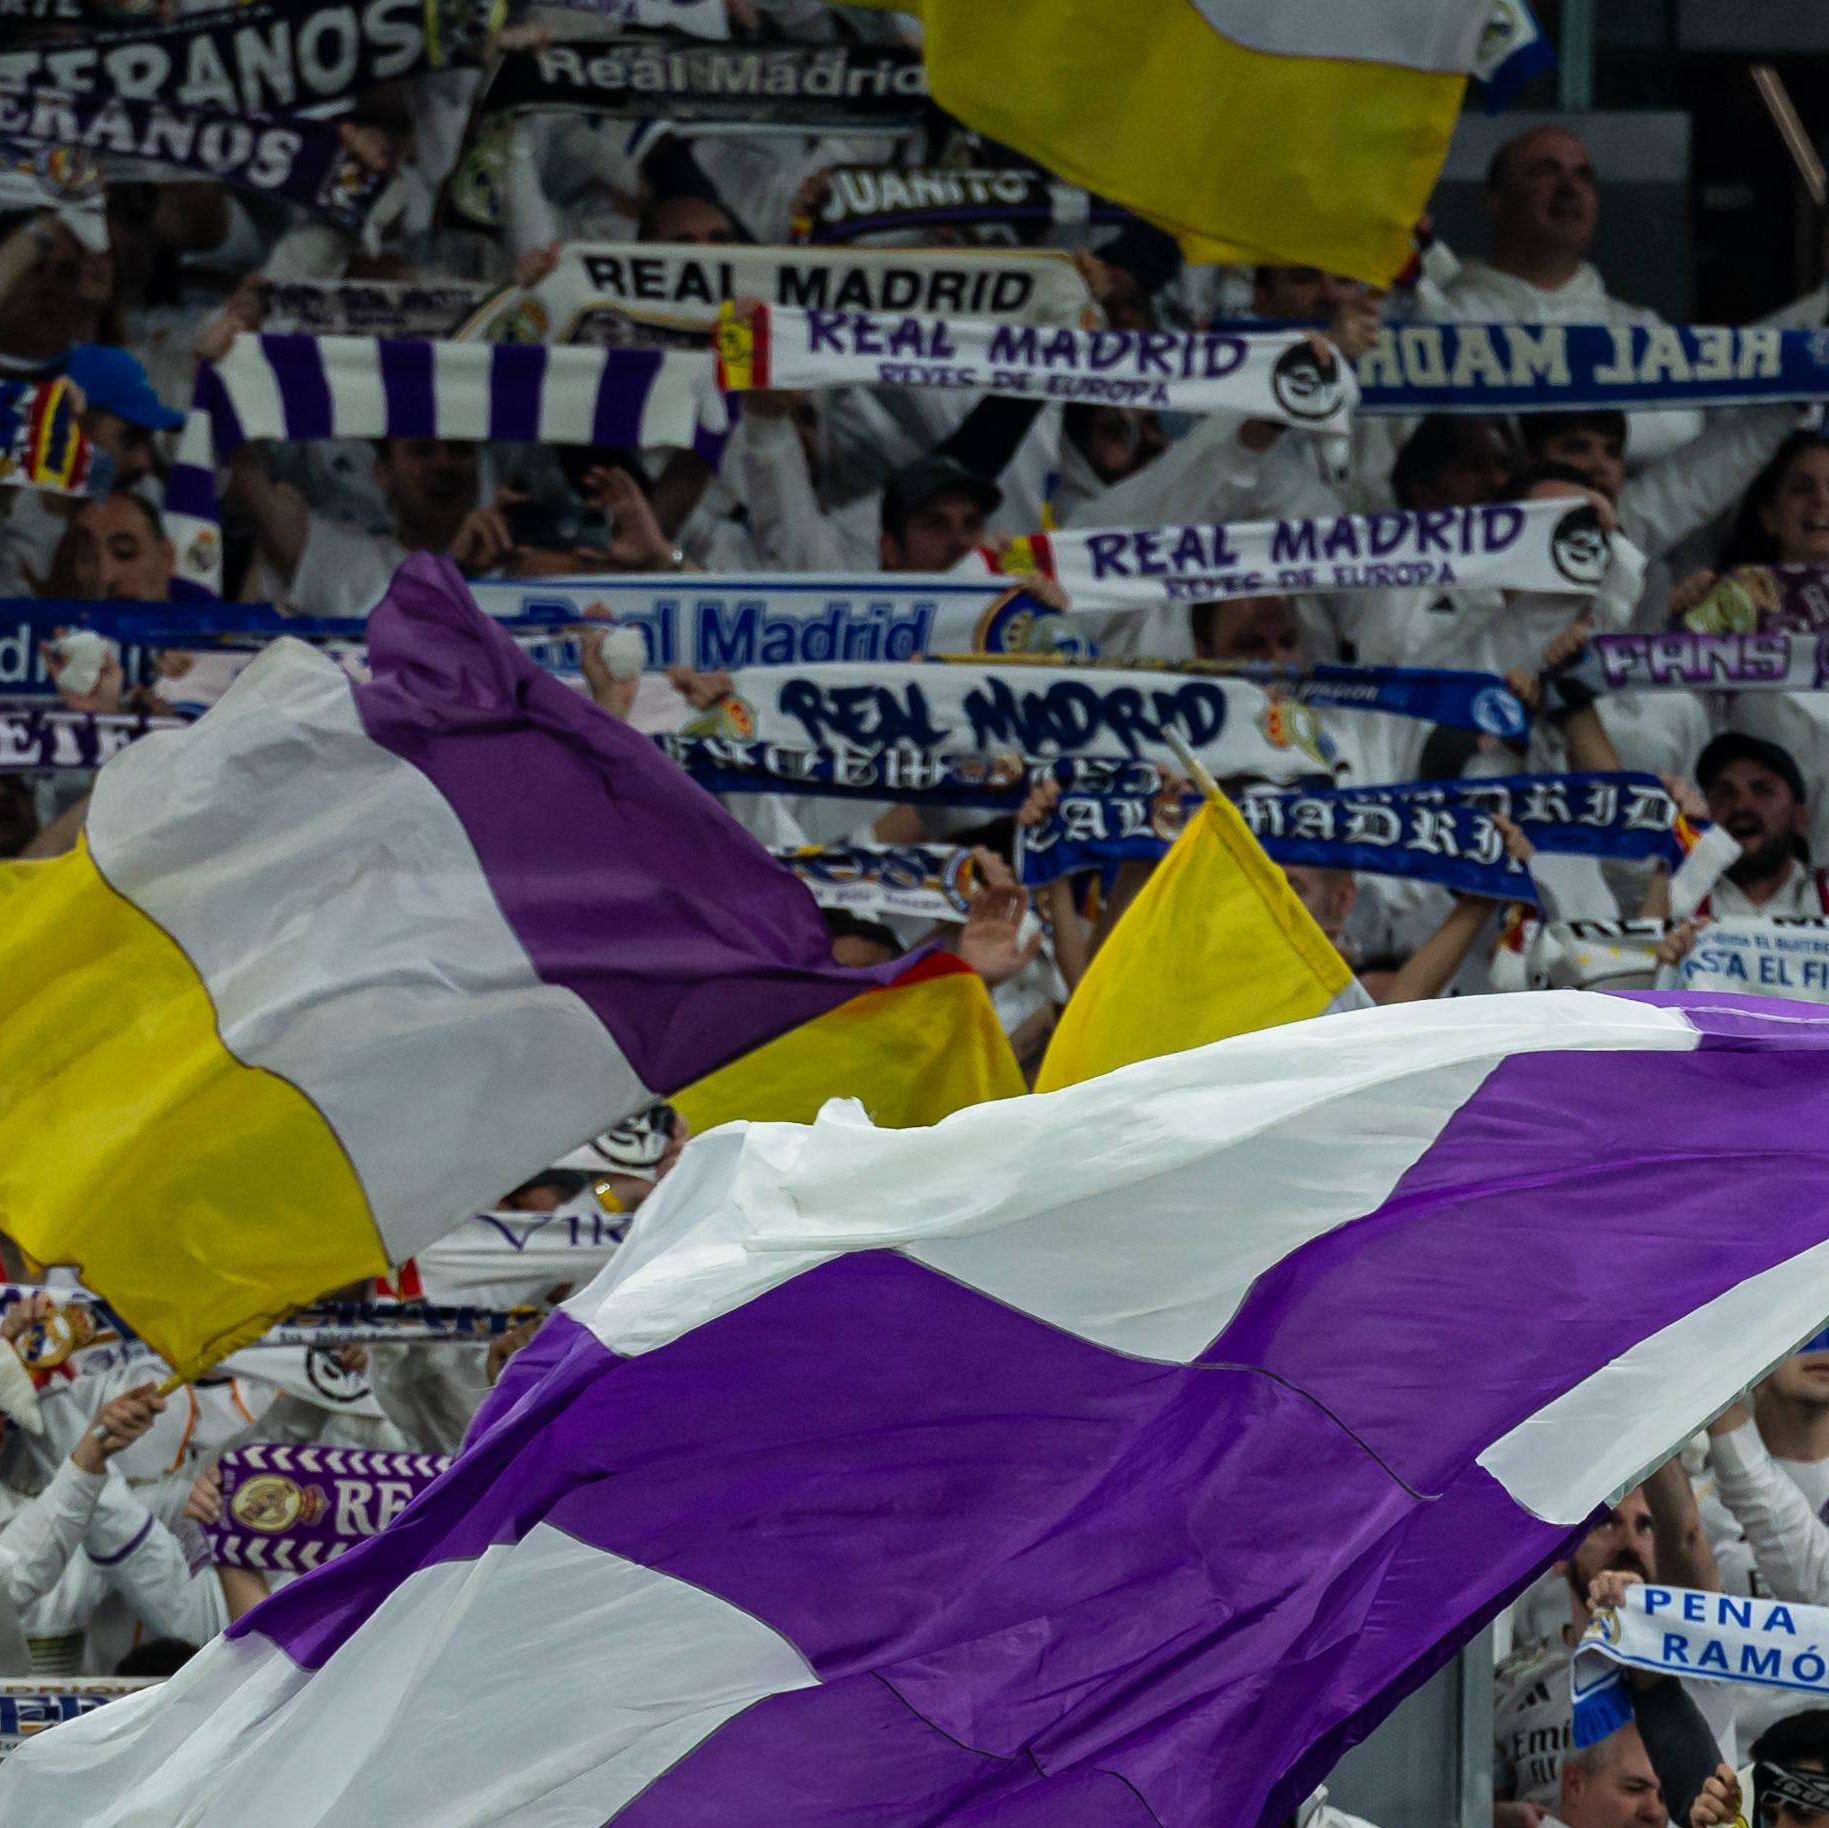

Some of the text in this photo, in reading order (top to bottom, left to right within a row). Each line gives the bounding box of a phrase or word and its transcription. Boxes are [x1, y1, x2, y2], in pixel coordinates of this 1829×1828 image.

[585, 255, 1034, 312] REAL MADRID
[987, 325, 1250, 378] MADRID
[1087, 505, 1529, 582] REAL MADRID
[697, 600, 940, 672] Madrid
[1758, 957, 1794, 987] EL
